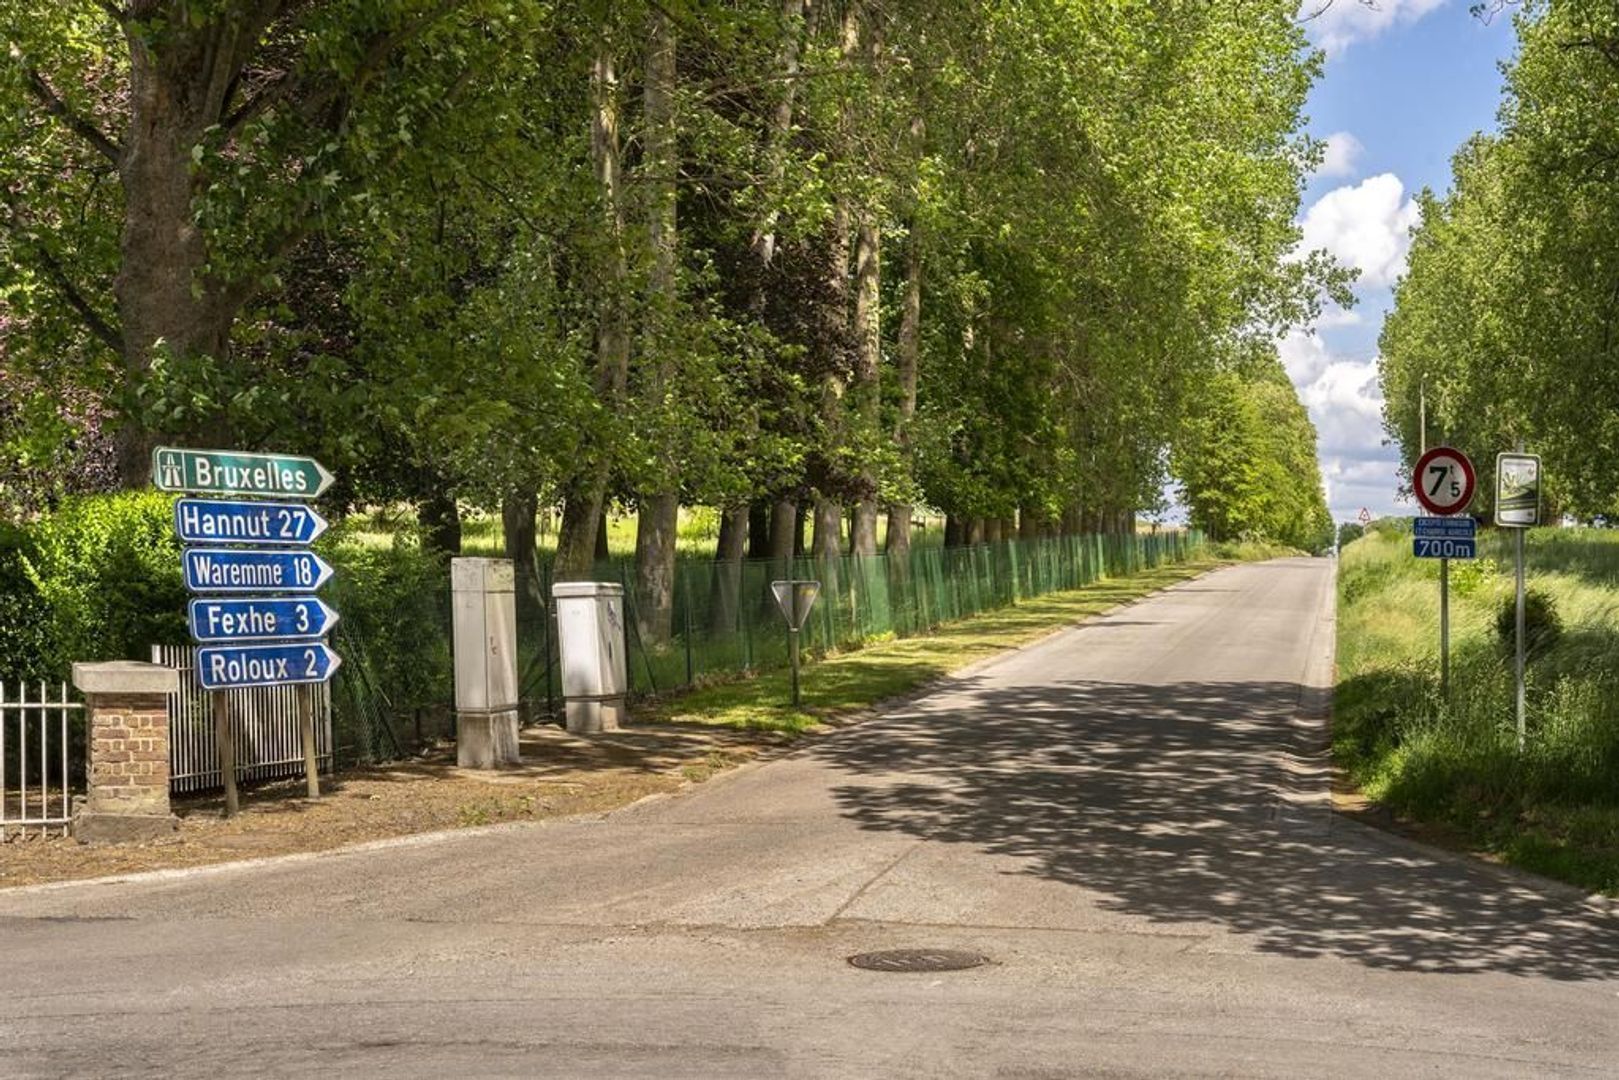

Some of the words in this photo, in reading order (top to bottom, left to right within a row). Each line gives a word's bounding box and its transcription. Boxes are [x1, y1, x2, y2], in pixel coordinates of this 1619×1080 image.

[194, 457, 308, 490] Bruxelles
[183, 505, 271, 537] Hannut
[278, 510, 307, 539] 27
[1419, 540, 1471, 557] 700m
[193, 555, 283, 585] Waremme
[293, 557, 312, 585] 18
[208, 605, 276, 635] Fexhe
[295, 604, 309, 632] 3
[210, 653, 288, 683] Roloux
[304, 649, 318, 677] 2
